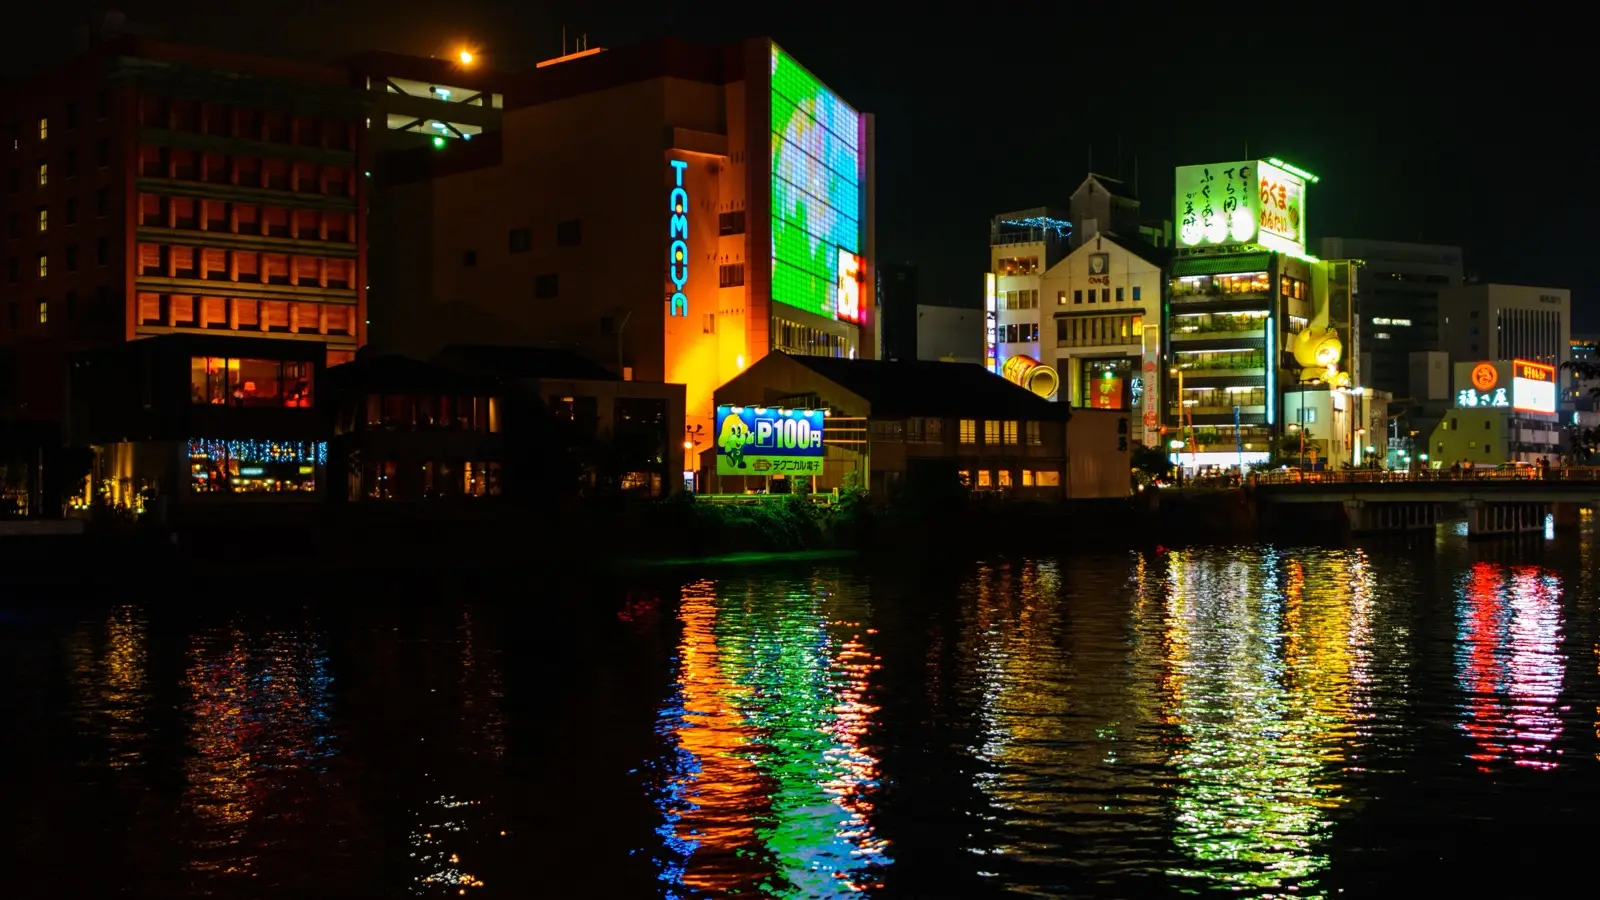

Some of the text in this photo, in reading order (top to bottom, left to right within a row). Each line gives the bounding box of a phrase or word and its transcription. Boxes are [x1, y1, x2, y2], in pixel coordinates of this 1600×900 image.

[670, 160, 688, 317] TAMAYA
[1458, 388, 1509, 406] 福さ屋
[773, 459, 820, 472] テクニカル電子
